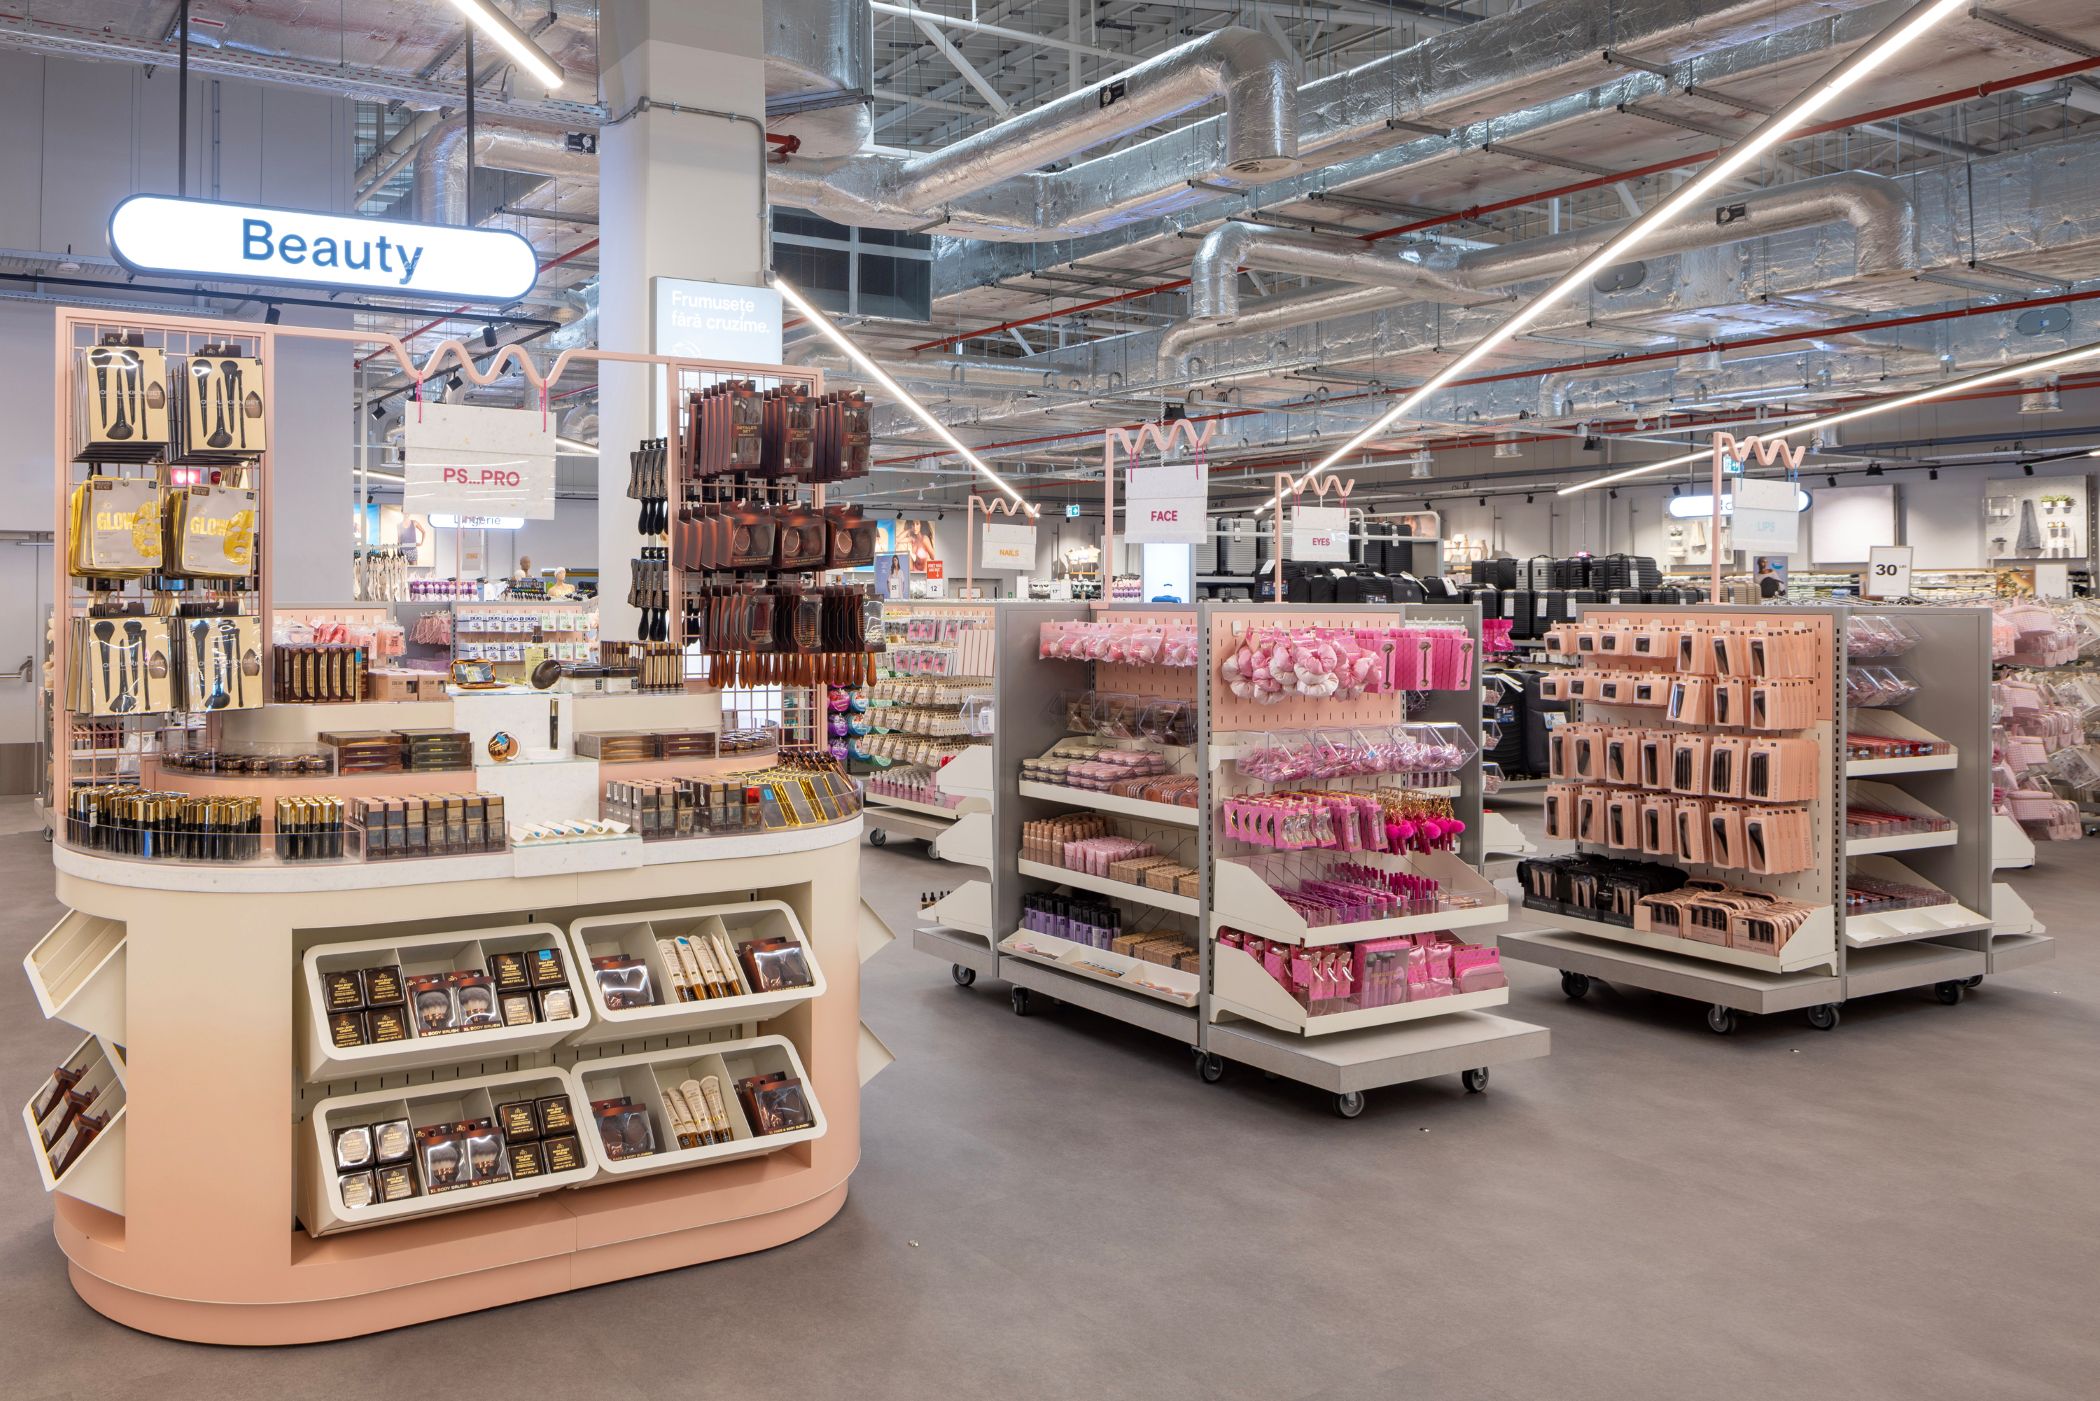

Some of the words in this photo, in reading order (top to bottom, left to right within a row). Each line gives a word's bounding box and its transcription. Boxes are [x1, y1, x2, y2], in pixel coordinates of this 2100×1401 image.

[243, 218, 424, 285] Beauty
[671, 290, 755, 317] Frumusețe
[705, 317, 770, 333] cruzime.
[96, 511, 136, 531] GLOW
[1150, 510, 1178, 522] FACE
[190, 516, 232, 537] GLOW
[1757, 520, 1776, 532] LIPS
[1312, 537, 1331, 546] EYES
[999, 549, 1020, 557] NAILS
[1875, 563, 1897, 576] 30
